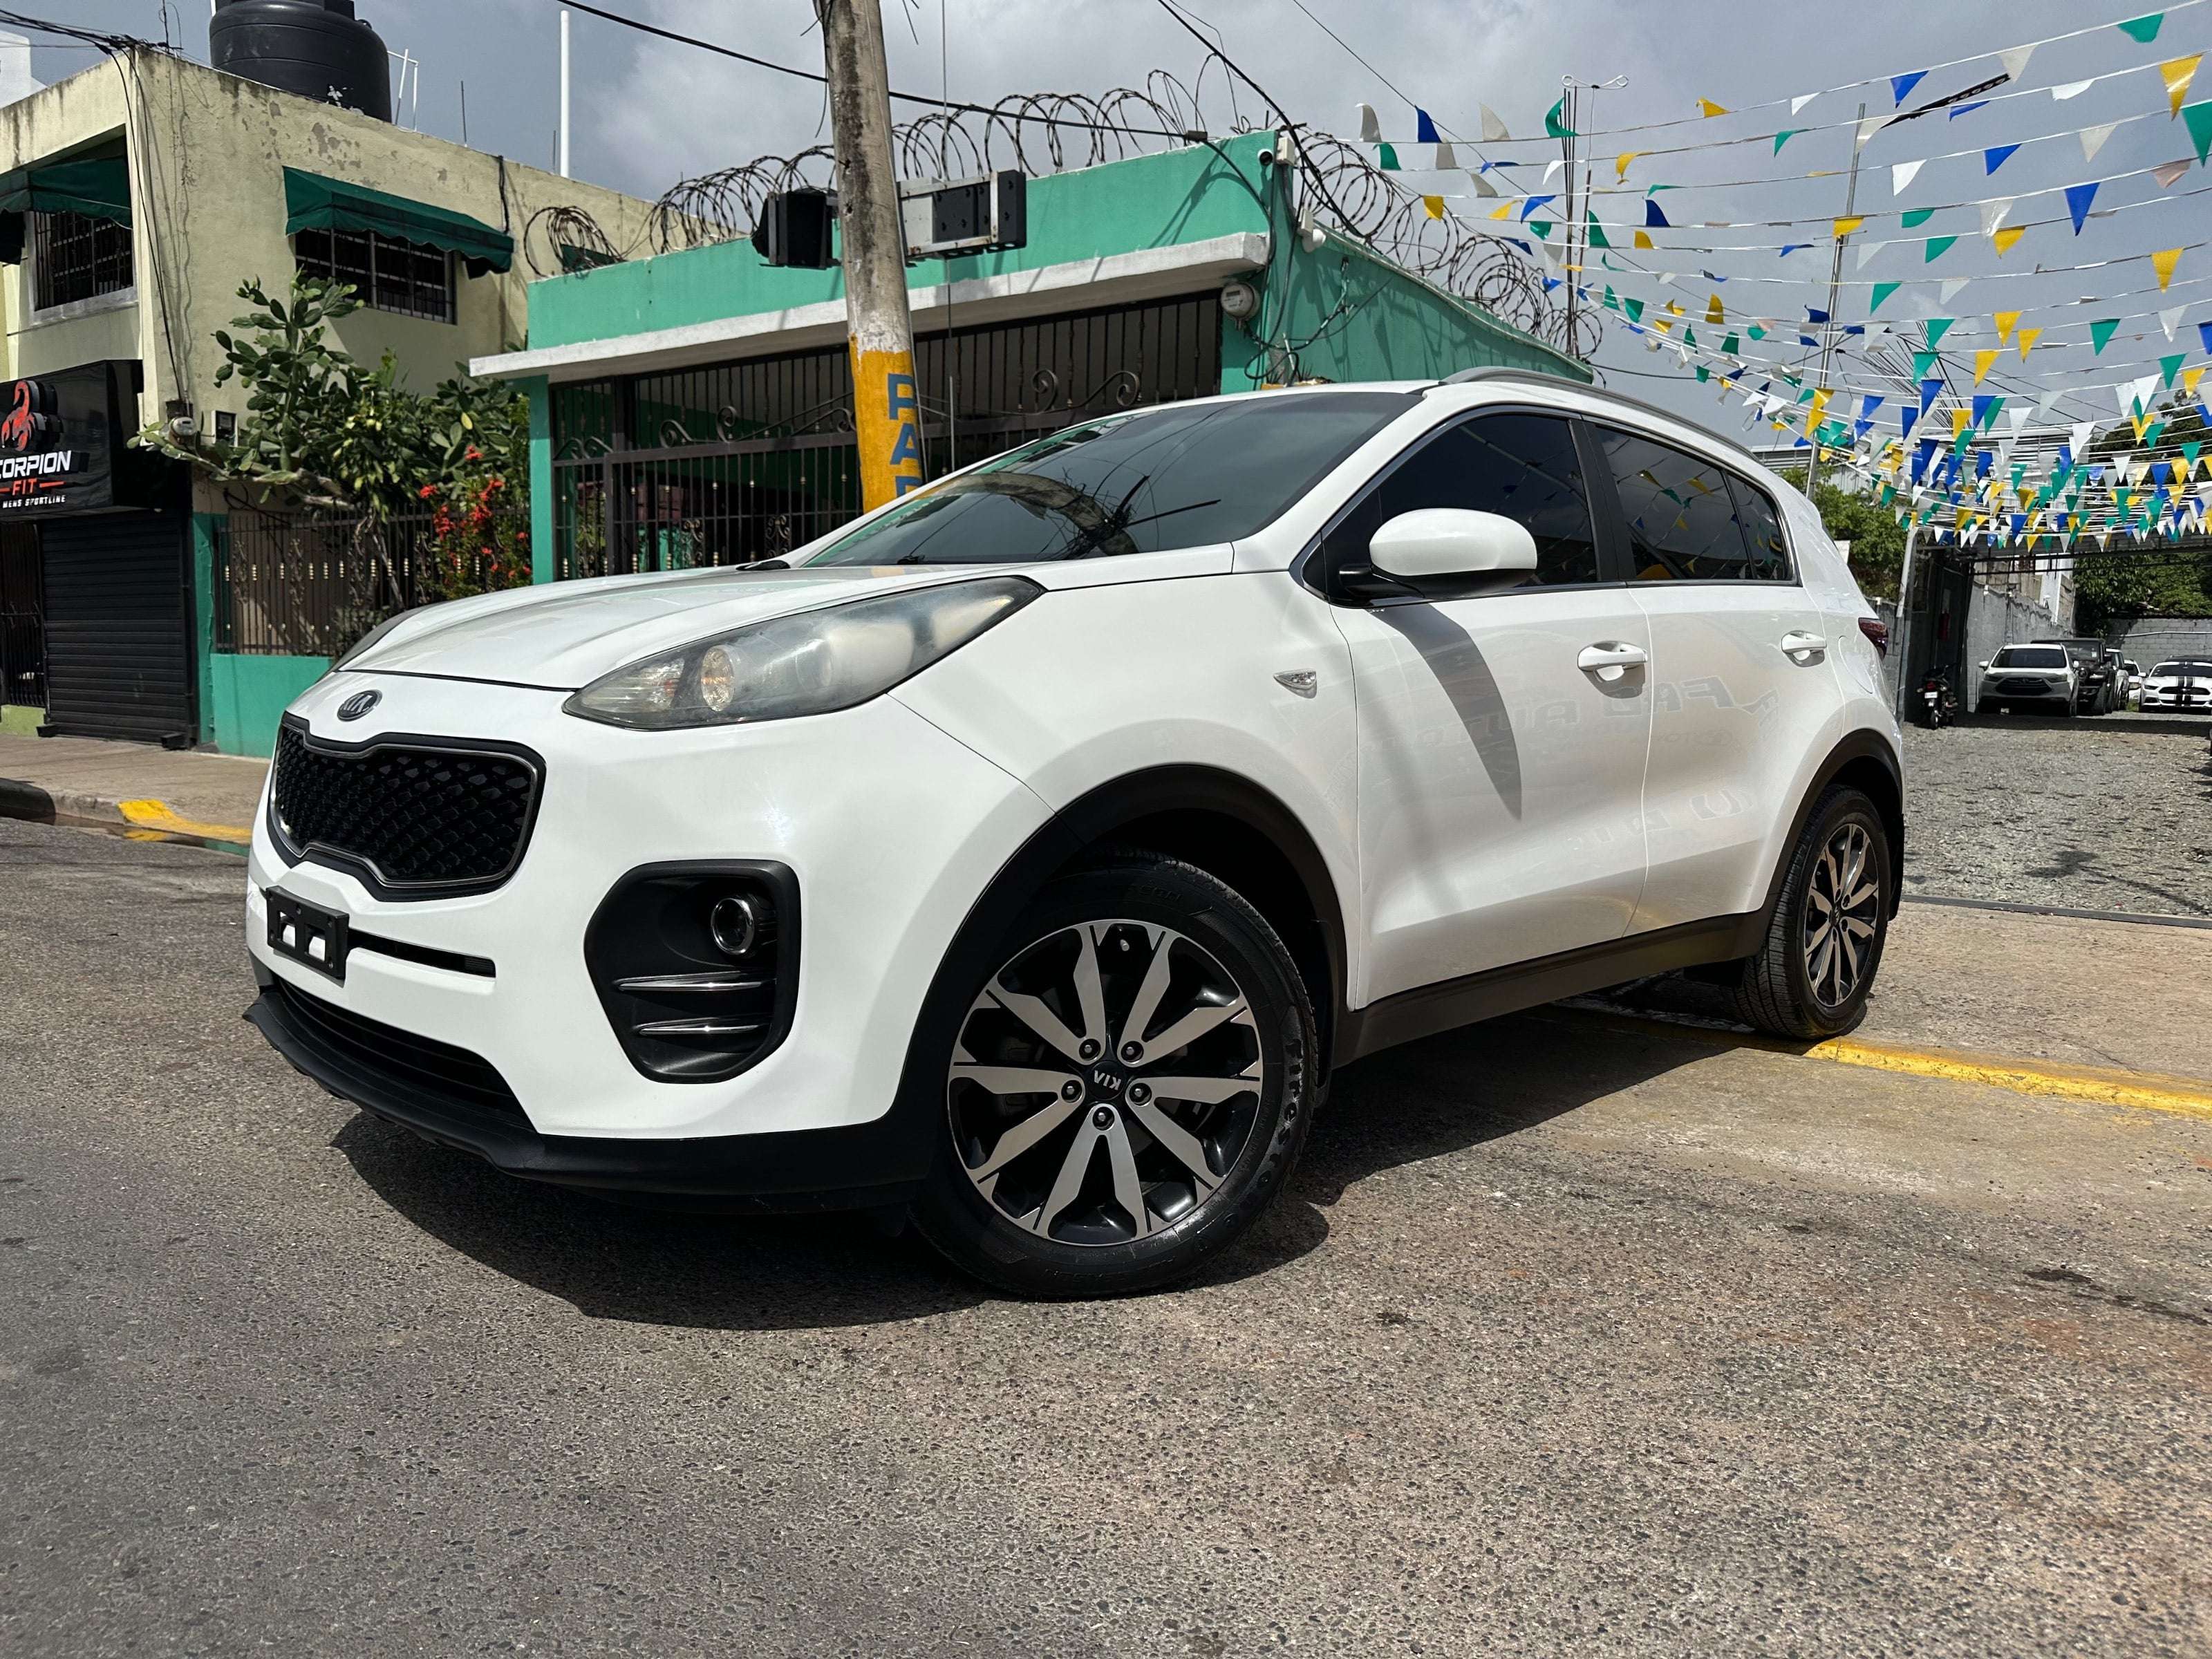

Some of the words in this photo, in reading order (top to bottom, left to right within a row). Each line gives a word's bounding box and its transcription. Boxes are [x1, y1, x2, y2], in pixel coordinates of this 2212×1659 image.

[0, 450, 71, 479] ORPION
[12, 478, 37, 496] FIT
[3, 498, 22, 508] MENS
[25, 495, 66, 507] SPORTLINE
[339, 693, 374, 715] KIA
[1094, 1070, 1121, 1090] KIA
